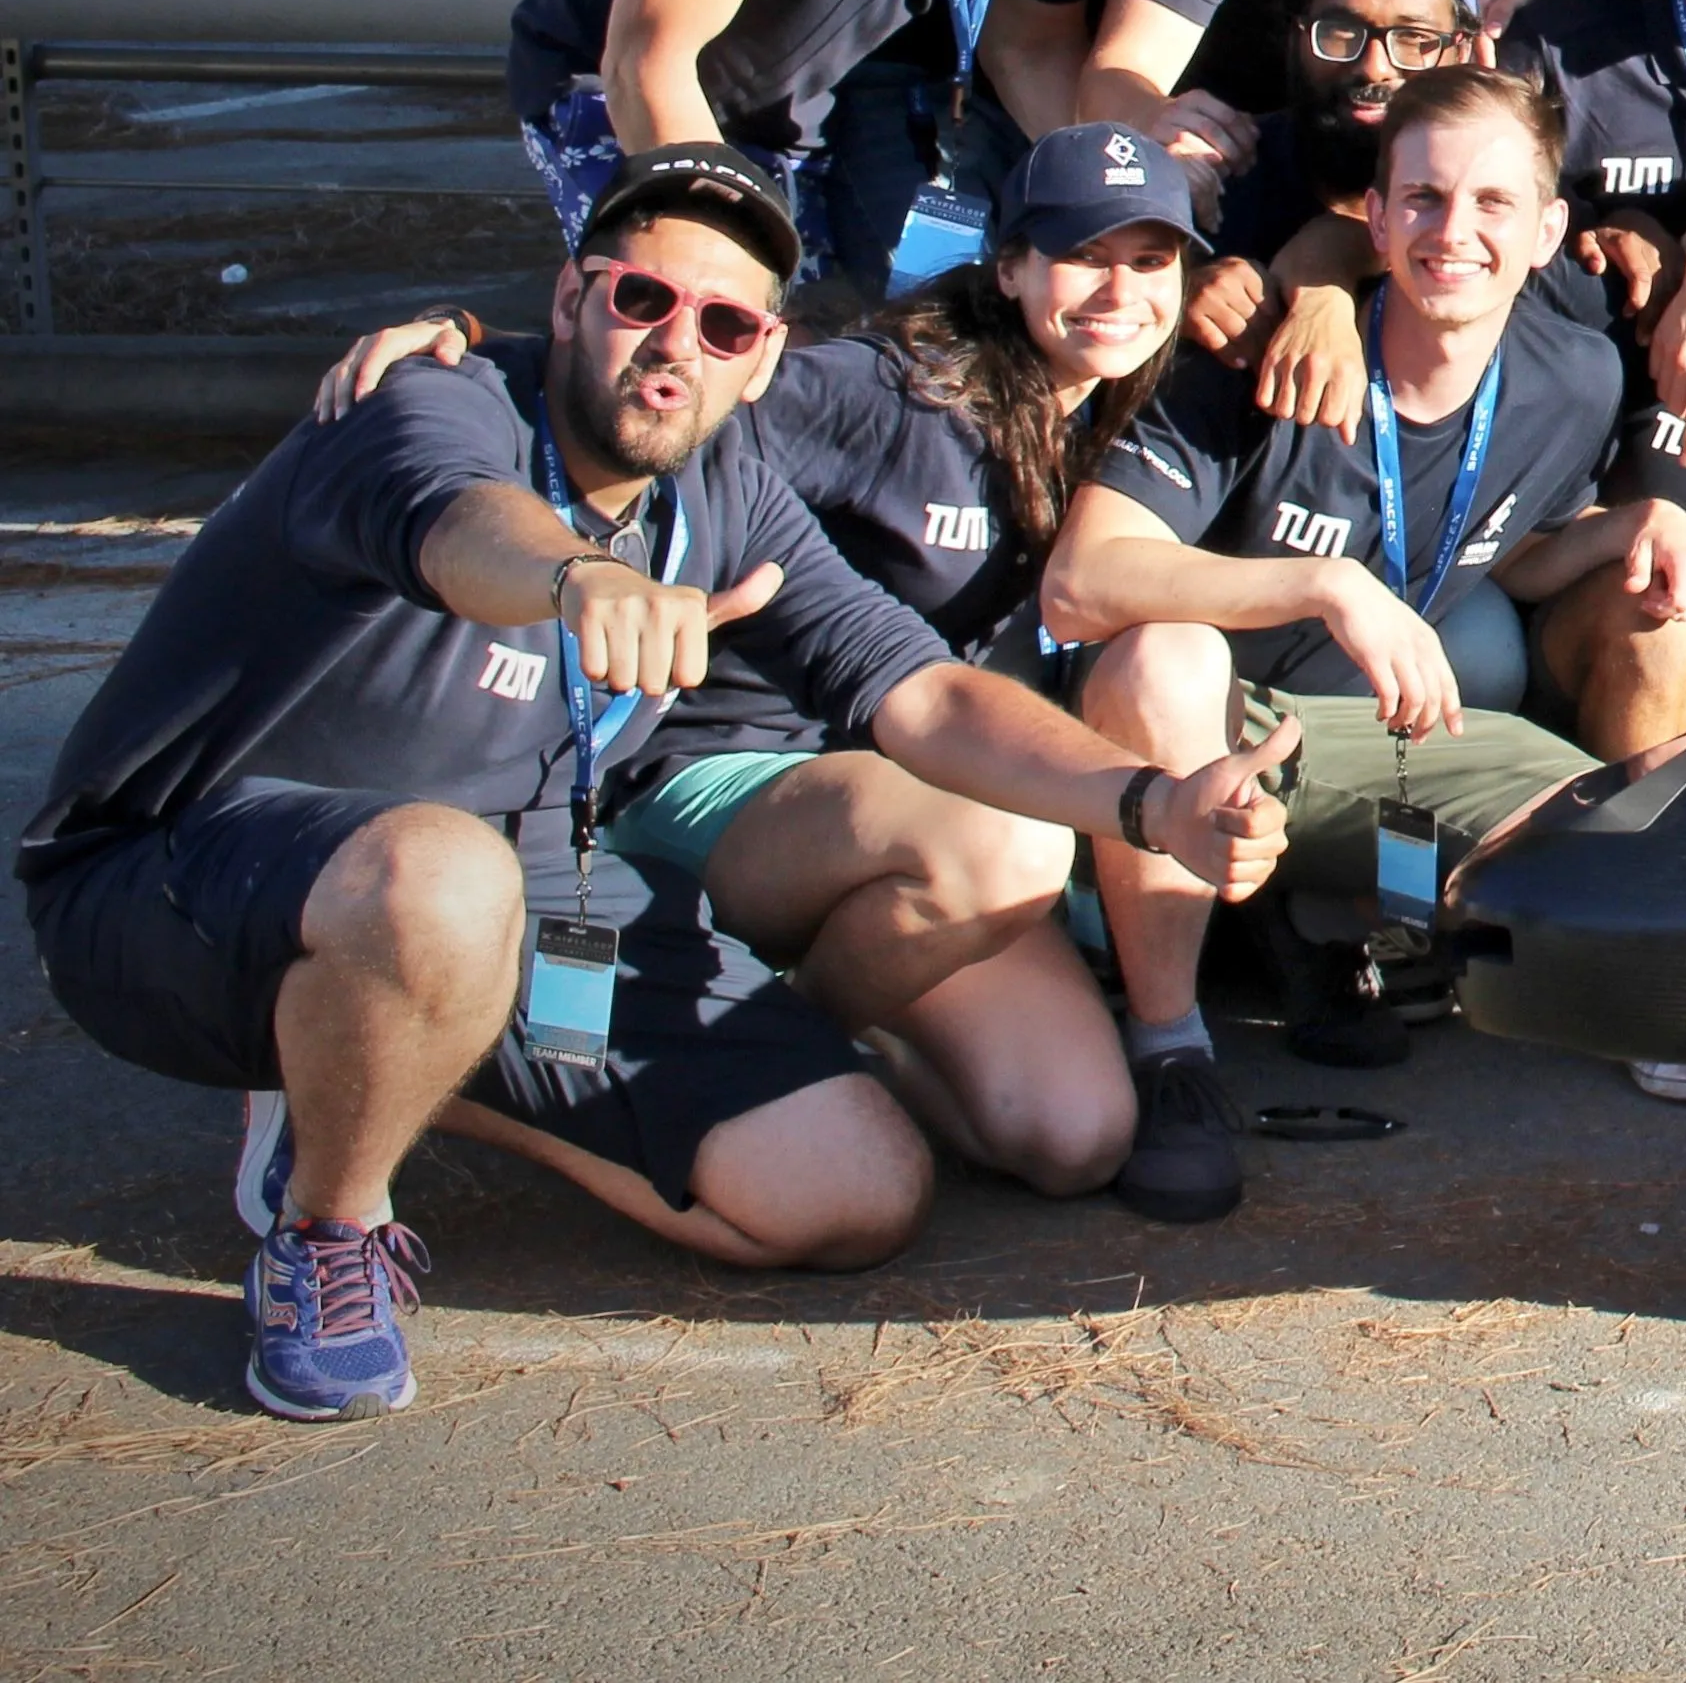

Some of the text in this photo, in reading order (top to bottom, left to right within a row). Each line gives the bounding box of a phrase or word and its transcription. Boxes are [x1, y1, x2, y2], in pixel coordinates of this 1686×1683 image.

[1603, 156, 1674, 195] TUM
[1466, 408, 1491, 473] SPACEX
[924, 502, 989, 551] TUM
[1272, 501, 1352, 559] TUM
[1383, 477, 1398, 546] SPACEX
[1434, 512, 1462, 575] SPACEX
[479, 641, 548, 702] TUM
[573, 685, 592, 758] SPACEX
[531, 1046, 598, 1069] TEAM MEMBER
